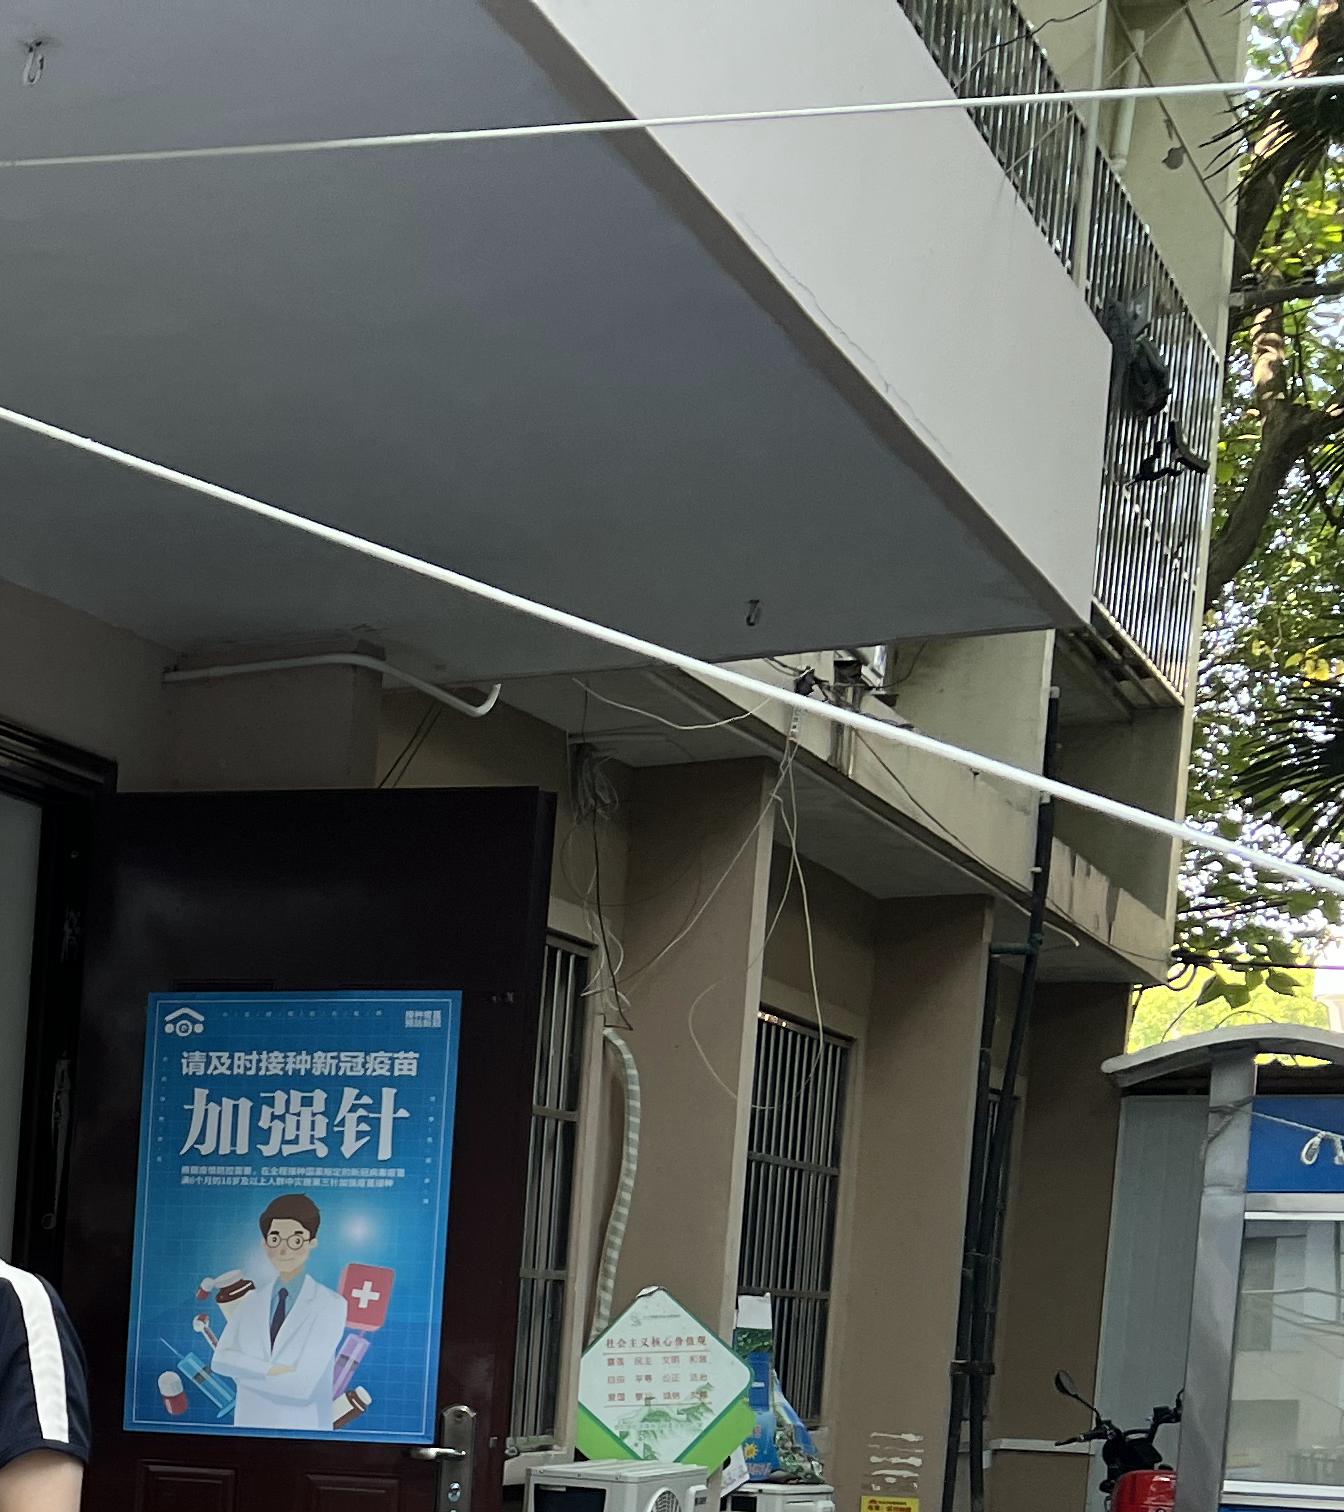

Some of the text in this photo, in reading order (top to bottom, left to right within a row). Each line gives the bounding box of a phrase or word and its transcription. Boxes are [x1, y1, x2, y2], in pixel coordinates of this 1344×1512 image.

[180, 1050, 420, 1078] 请及时接种新冠疫苗
[179, 1086, 411, 1161] 加强针
